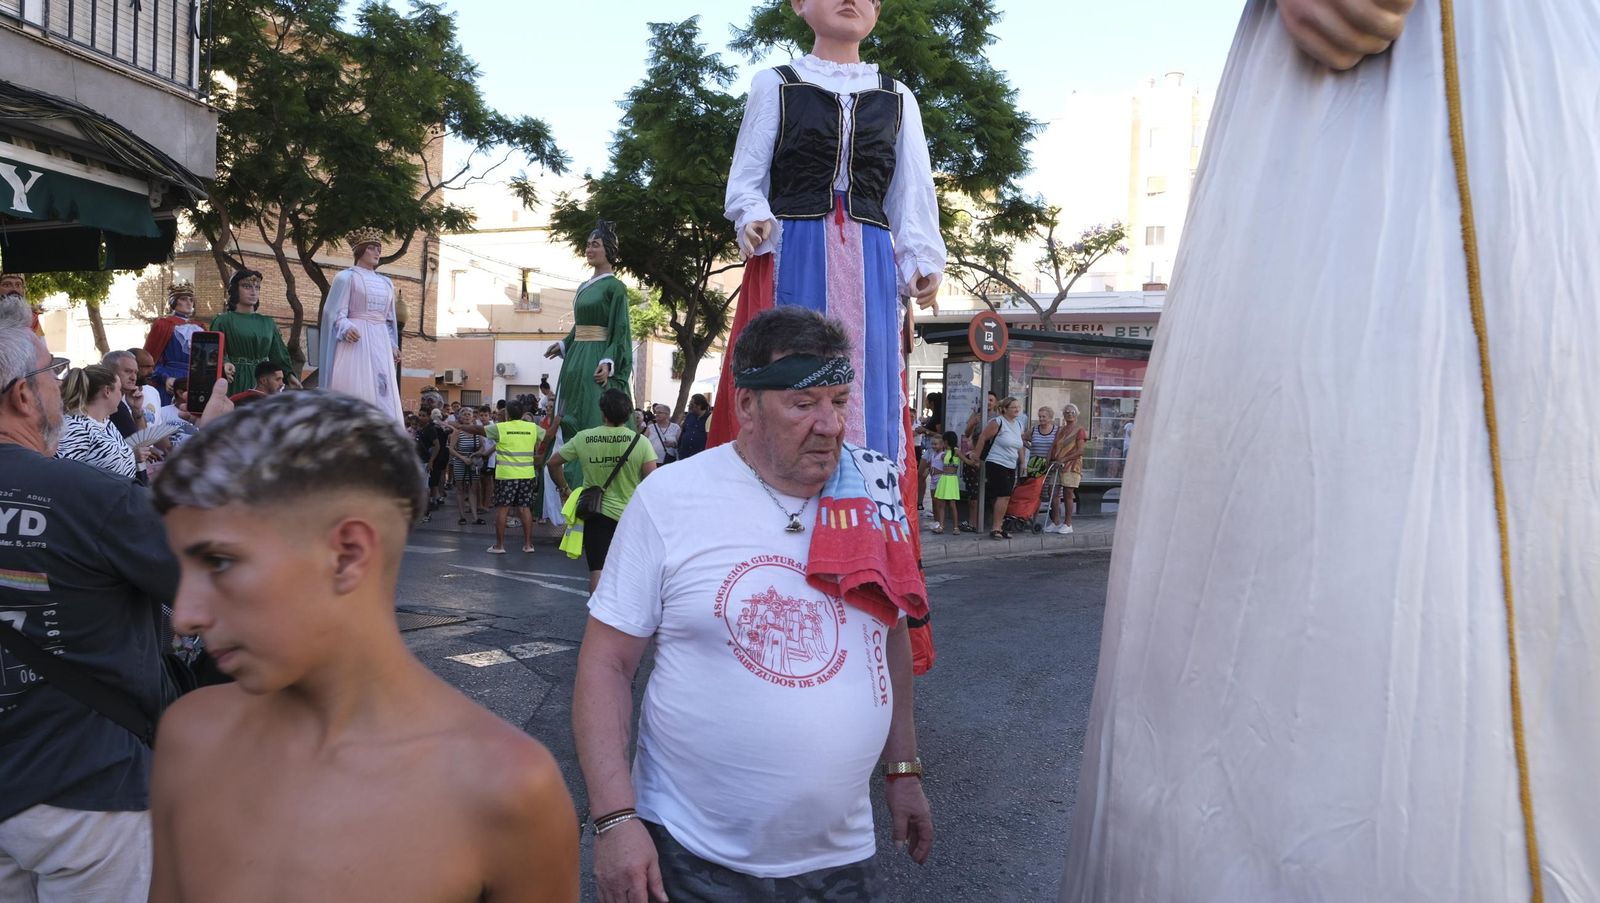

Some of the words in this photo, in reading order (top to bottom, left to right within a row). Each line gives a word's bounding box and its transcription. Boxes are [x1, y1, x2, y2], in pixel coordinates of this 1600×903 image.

[0, 162, 44, 213] Y
[1021, 324, 1104, 332] CARICERIA
[585, 434, 632, 444] ORGANIZACIÓN
[27, 494, 52, 503] ADULT
[714, 561, 750, 618] ASOCIACIÓN
[733, 648, 796, 688] CABEZUDOS
[798, 678, 815, 688] DE
[872, 630, 888, 706] COLOR
